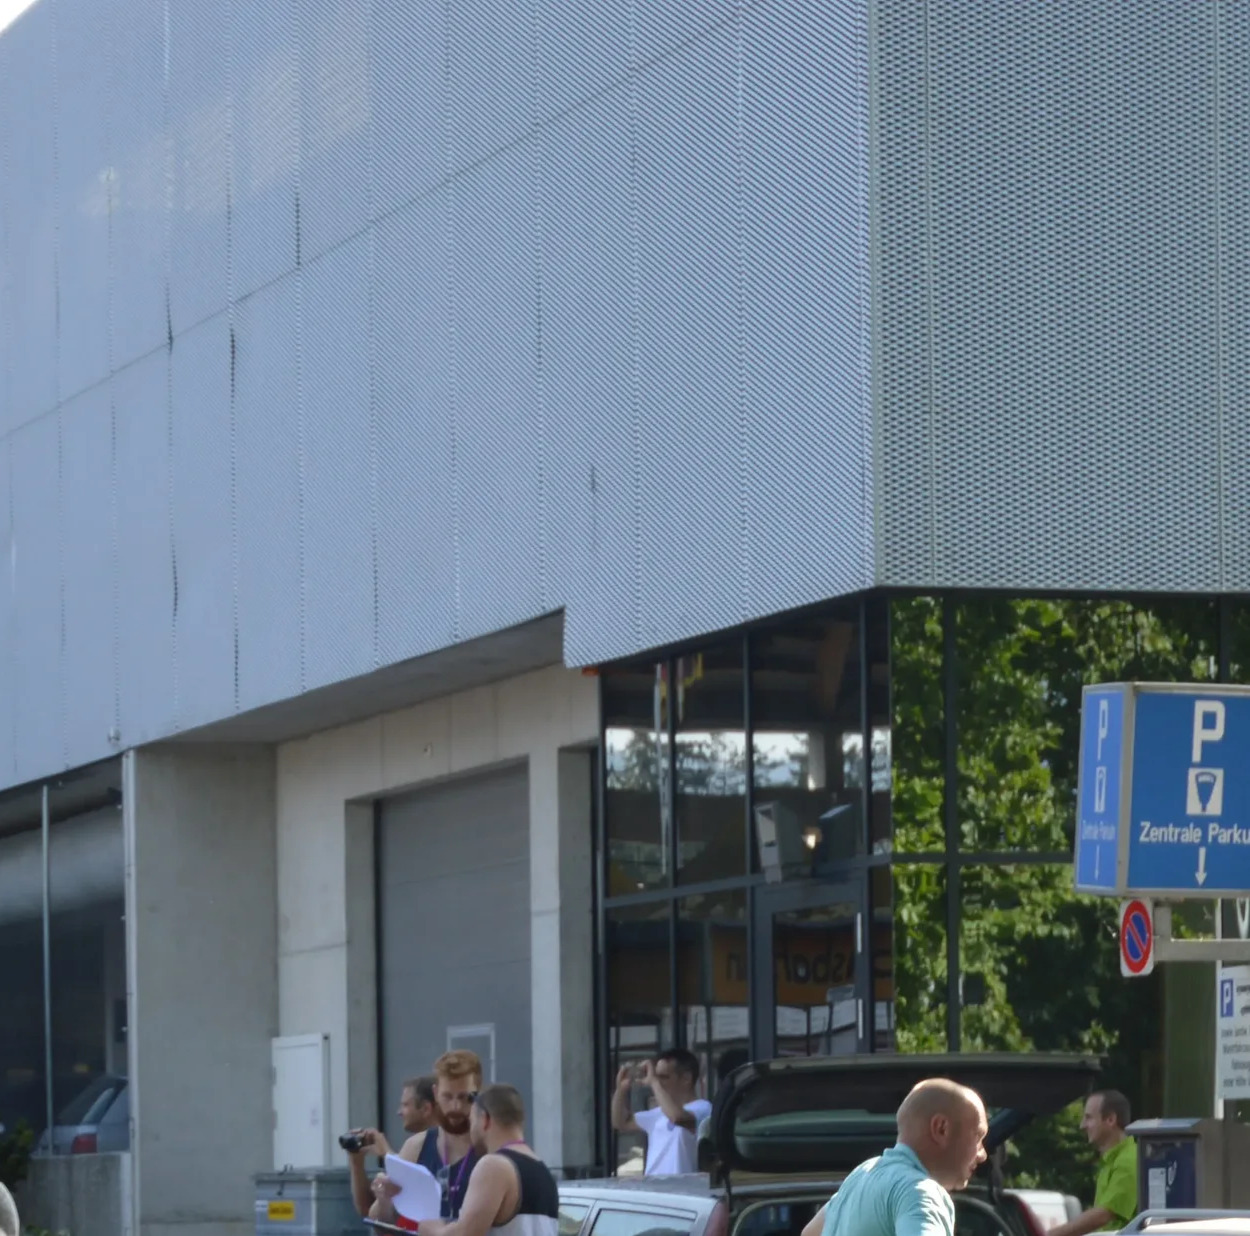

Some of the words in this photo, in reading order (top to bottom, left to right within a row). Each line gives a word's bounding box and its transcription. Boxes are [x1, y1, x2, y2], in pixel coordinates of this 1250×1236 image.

[1098, 700, 1108, 761] P
[1192, 700, 1226, 763] P
[1139, 820, 1202, 843] Zentrale
[1207, 822, 1250, 845] Parku
